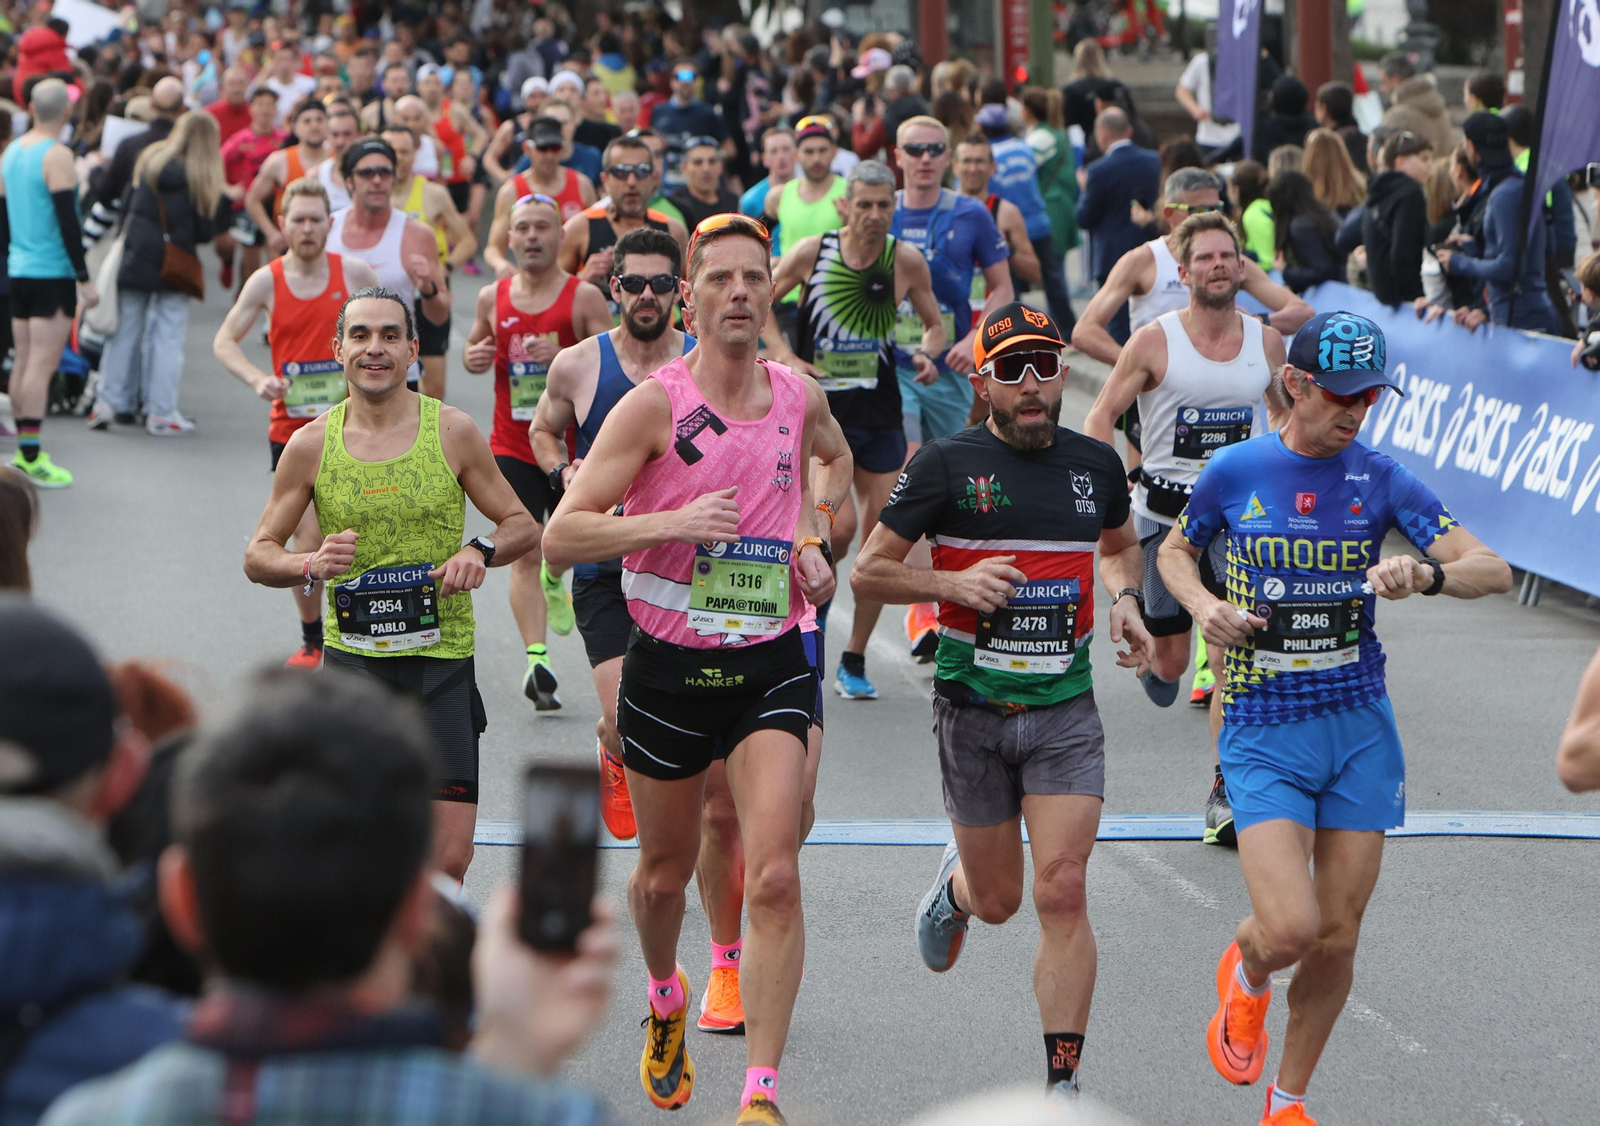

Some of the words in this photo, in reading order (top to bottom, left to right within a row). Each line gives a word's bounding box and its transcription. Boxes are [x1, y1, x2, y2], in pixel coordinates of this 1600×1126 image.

[988, 317, 1013, 336] OTSO
[1204, 411, 1245, 421] ZURICH
[1392, 374, 1451, 457] asics
[1201, 433, 1227, 443] 2286
[1455, 393, 1522, 478] asics
[1523, 415, 1595, 500] asics
[363, 486, 389, 495] luanvi
[966, 482, 1001, 495] RUN
[957, 495, 1012, 510] KENYA
[1075, 500, 1096, 514] OTSO
[732, 542, 783, 559] ZURICH
[367, 569, 422, 585] ZURICH
[729, 572, 763, 589] 1316
[1015, 585, 1070, 599] ZURICH
[1292, 582, 1353, 595] ZURICH
[369, 599, 403, 614] 2954
[705, 596, 777, 614] PAPA@TOÑIN
[699, 616, 714, 624] asics
[1011, 616, 1047, 631] 2478
[1291, 613, 1330, 629] 2846
[370, 621, 407, 635] PABLO
[987, 637, 1068, 653] JUANITASTYLE
[1283, 637, 1338, 651] PHILIPPE
[685, 674, 744, 688] HANKER
